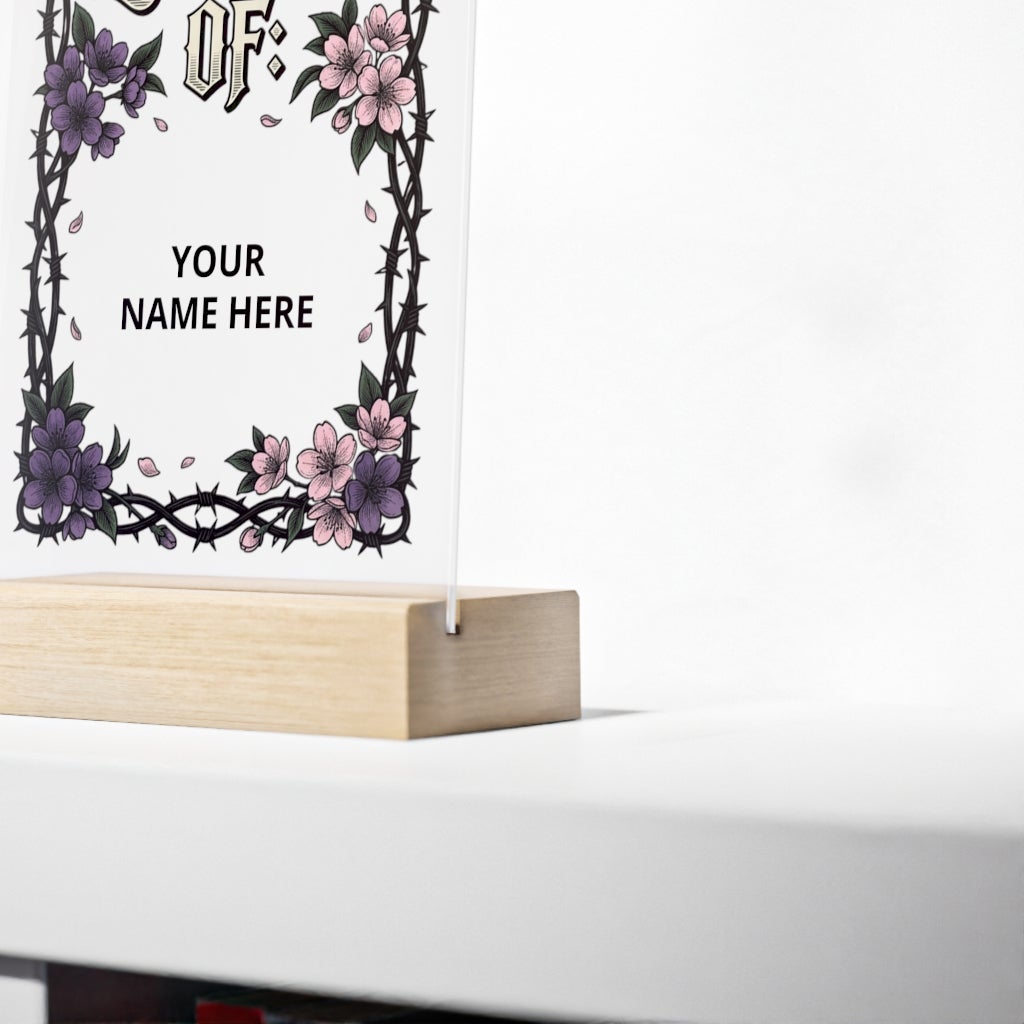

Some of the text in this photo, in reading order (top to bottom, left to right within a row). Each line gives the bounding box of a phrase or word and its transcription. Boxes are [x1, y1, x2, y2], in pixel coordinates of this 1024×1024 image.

[171, 244, 265, 278] YOUR
[121, 295, 314, 330] NAME HERE
